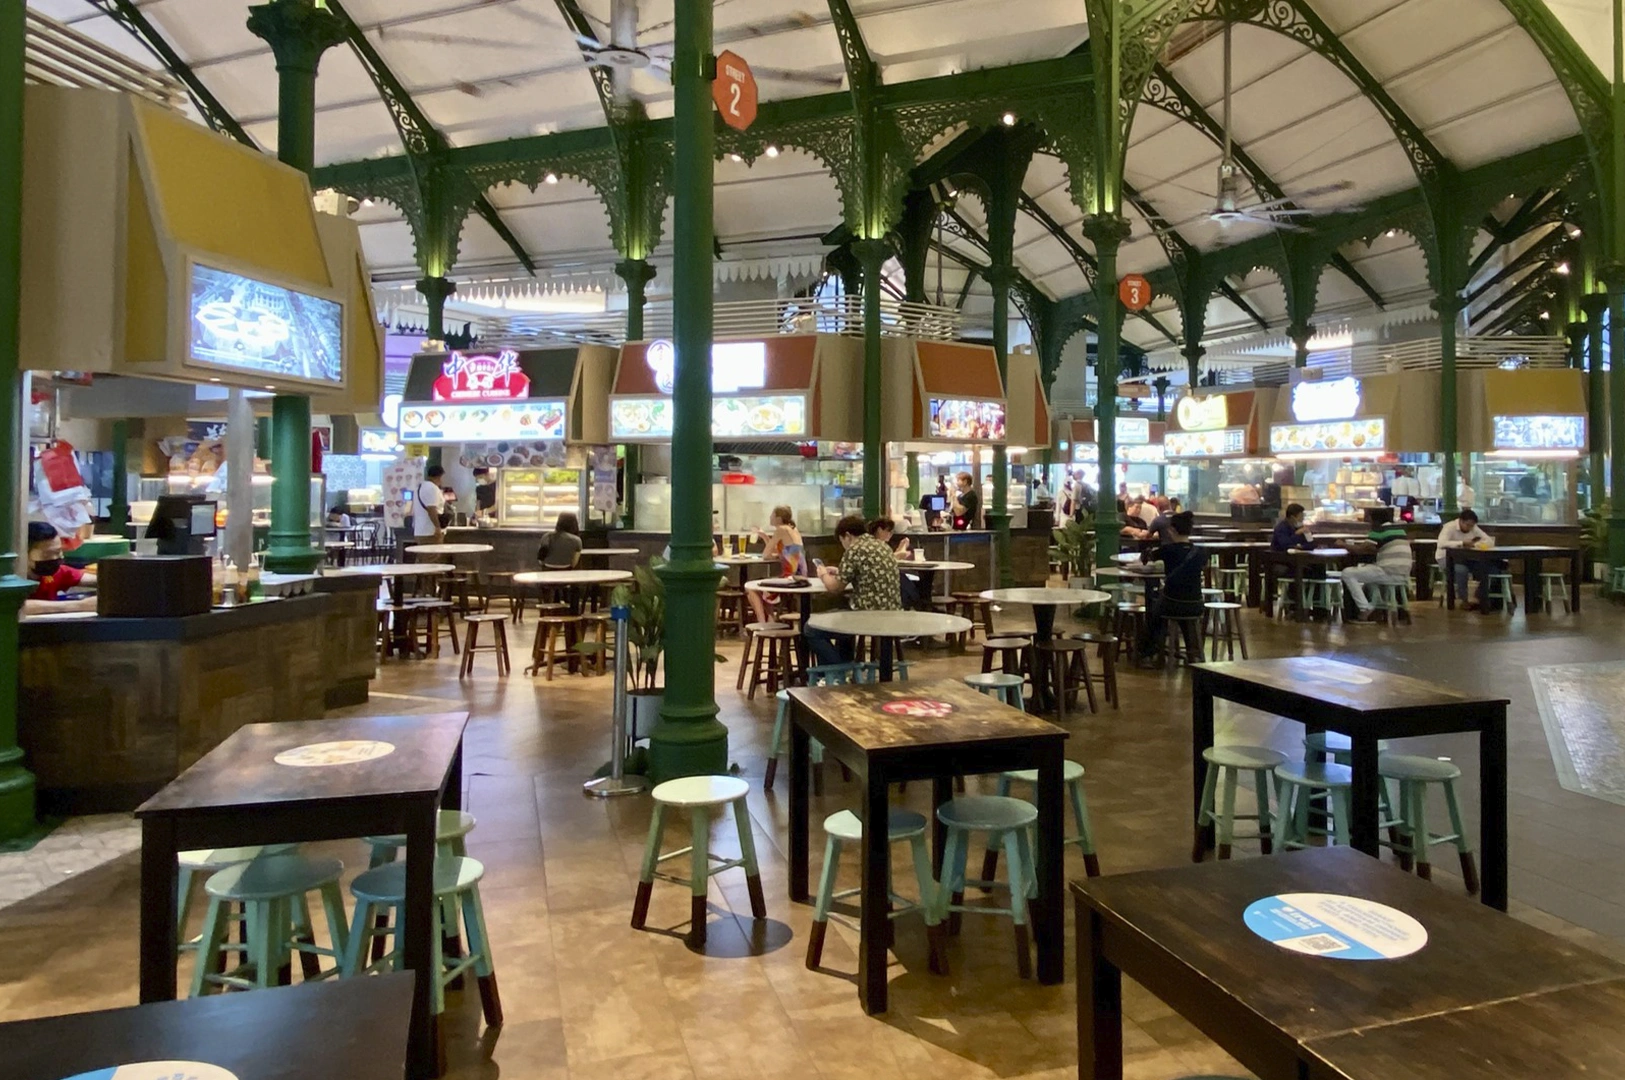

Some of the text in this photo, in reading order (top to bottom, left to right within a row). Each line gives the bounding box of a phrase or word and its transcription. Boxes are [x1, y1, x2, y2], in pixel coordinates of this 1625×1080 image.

[725, 64, 745, 84] STREET
[730, 83, 741, 117] 2
[1131, 287, 1139, 304] 3
